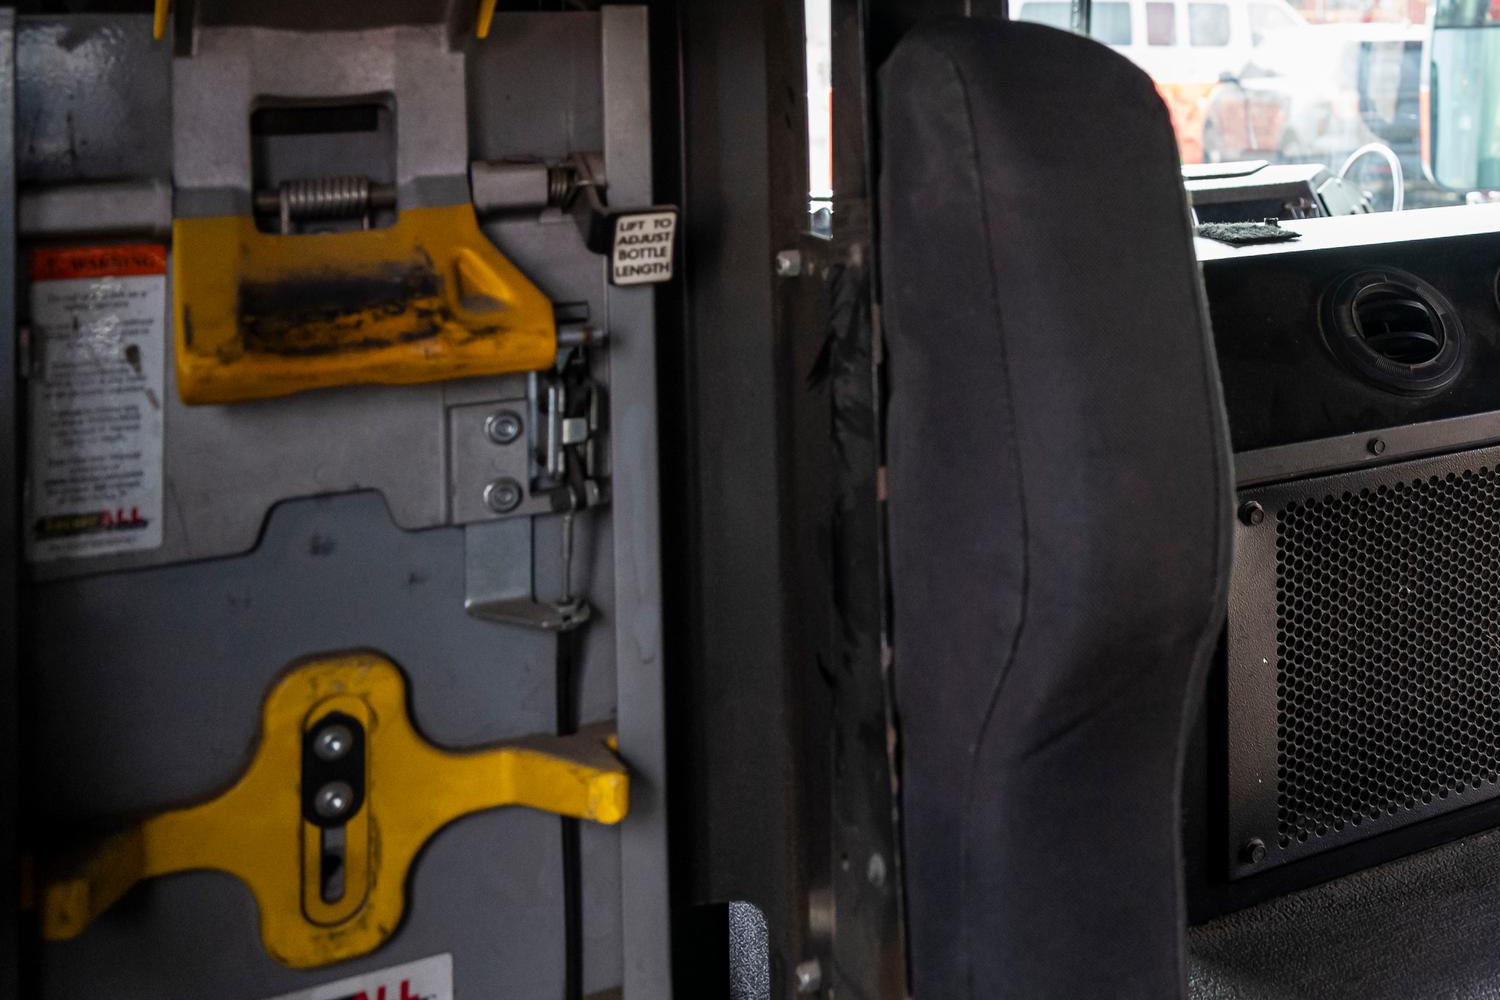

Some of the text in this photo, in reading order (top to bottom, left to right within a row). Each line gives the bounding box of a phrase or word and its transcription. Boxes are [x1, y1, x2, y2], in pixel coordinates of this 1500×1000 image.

[620, 218, 672, 231] LIFT TO
[617, 231, 670, 245] ADJUST
[618, 246, 667, 261] BOTTLE
[615, 262, 669, 277] LENGTH
